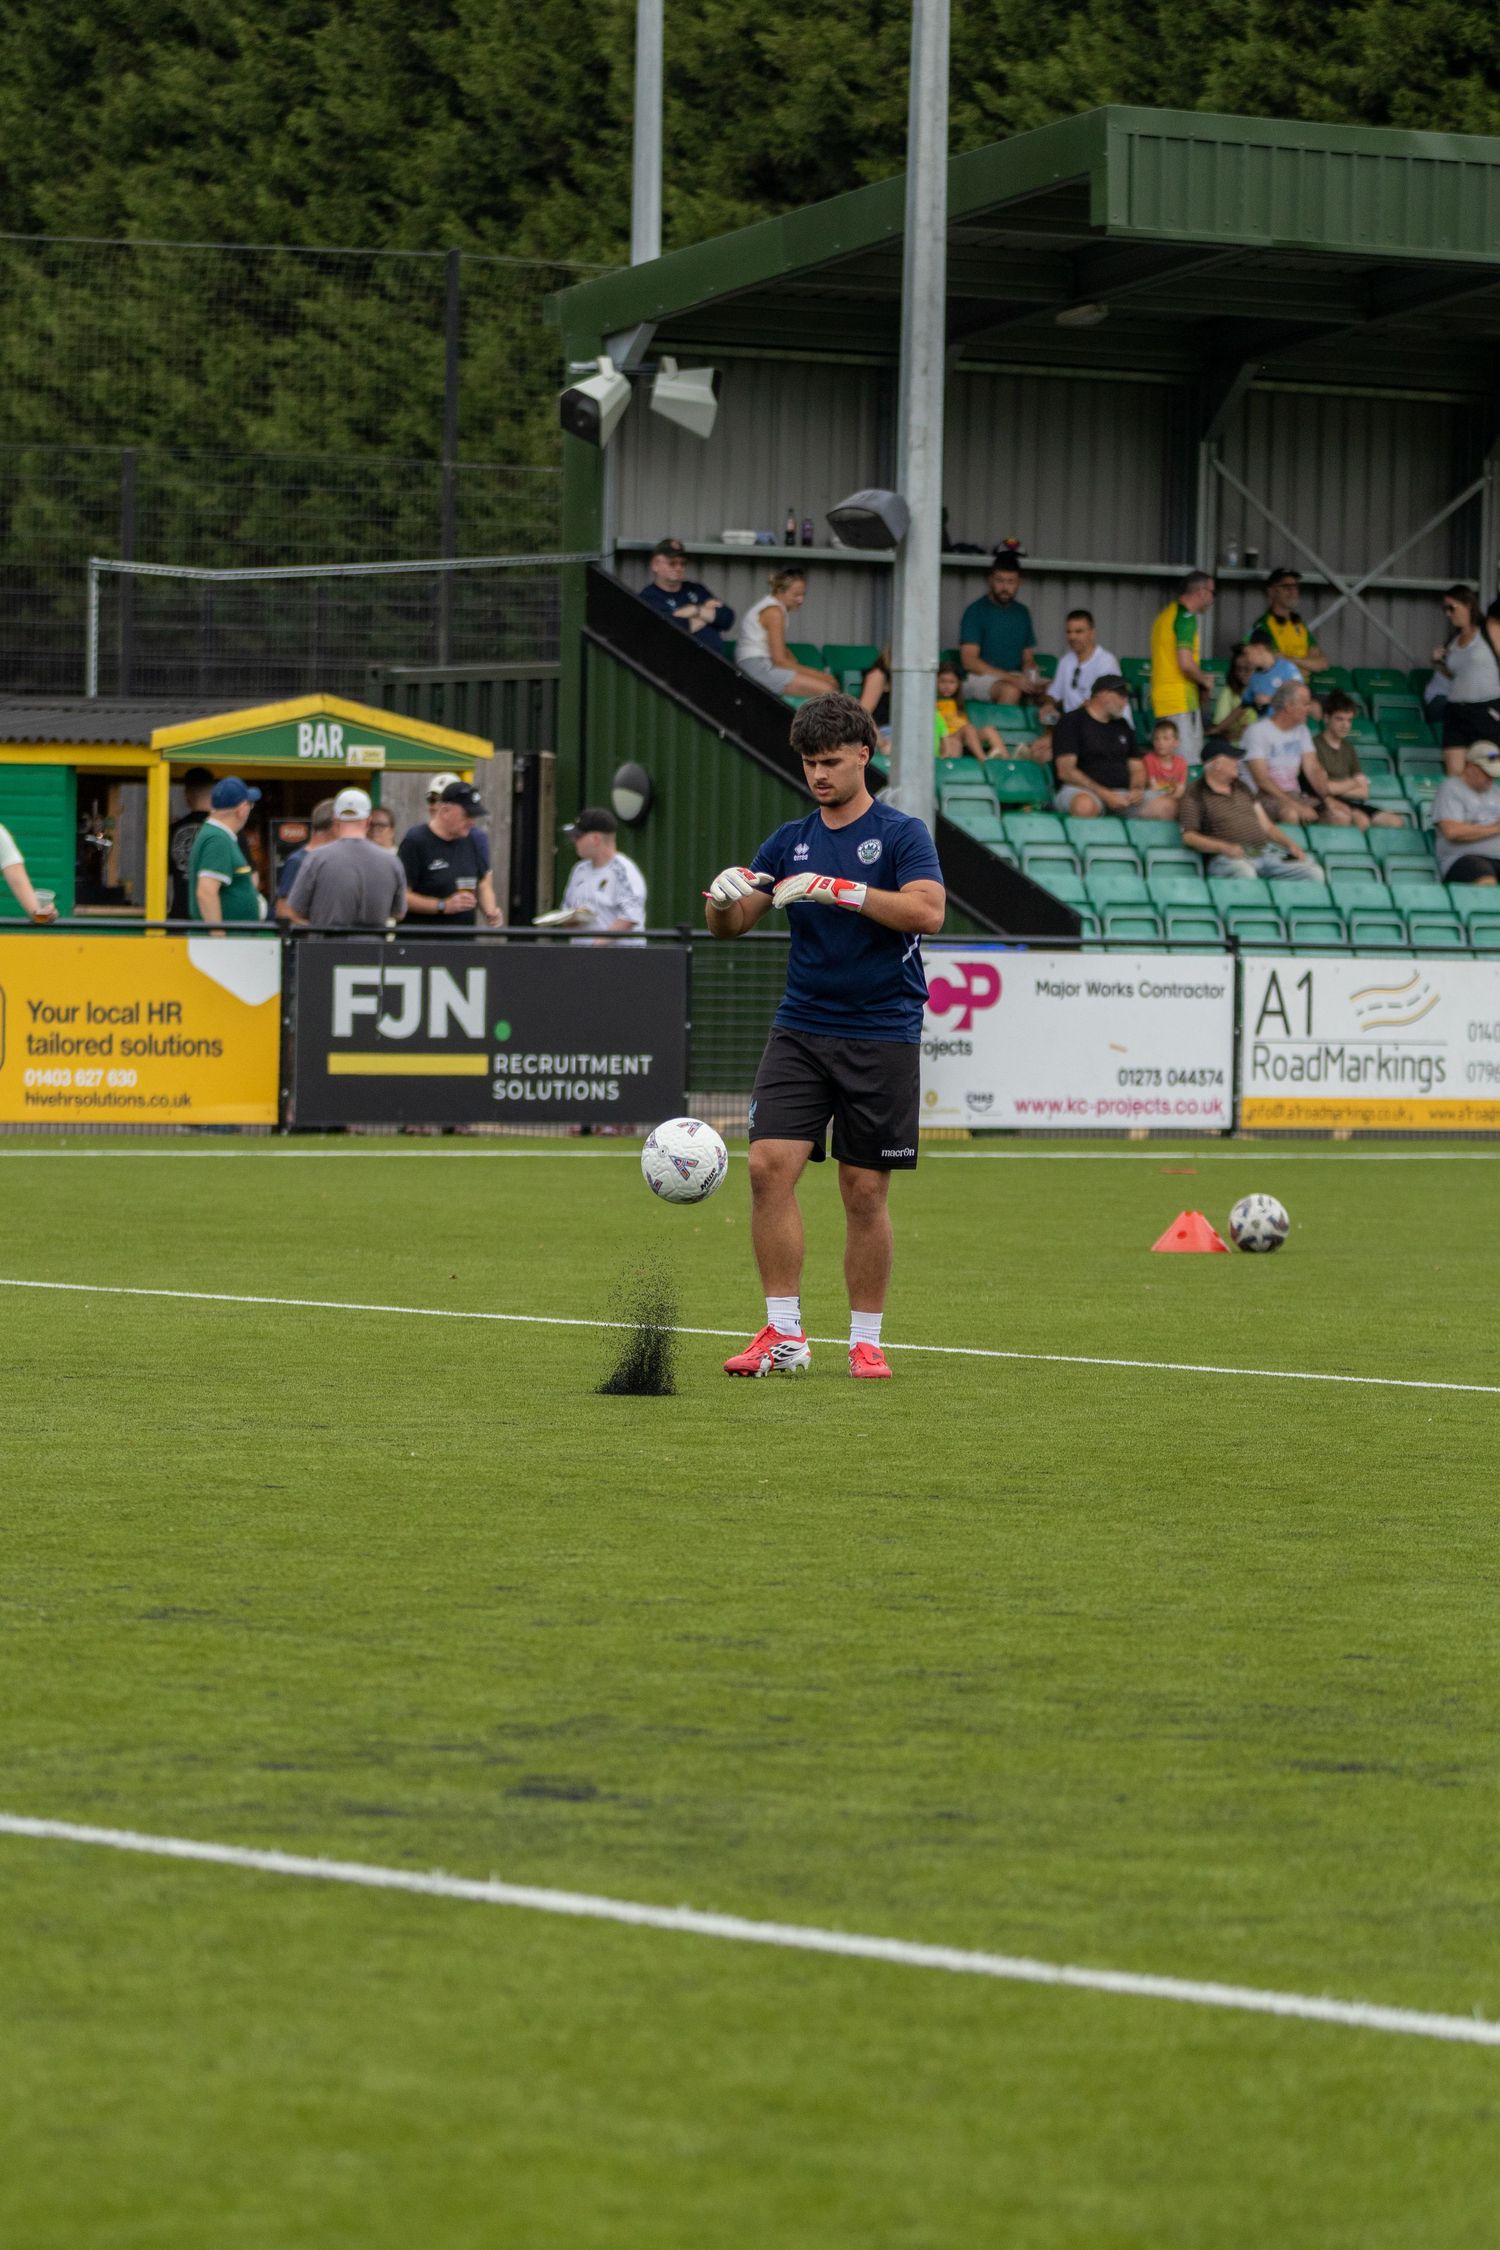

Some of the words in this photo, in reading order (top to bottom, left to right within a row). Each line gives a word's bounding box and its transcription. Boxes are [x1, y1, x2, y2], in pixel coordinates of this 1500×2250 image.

[298, 722, 344, 758] BAR
[1036, 980, 1082, 999] Major
[1085, 981, 1134, 998] Works
[1138, 982, 1225, 999] Contractor
[26, 1000, 79, 1024] Your
[86, 1001, 140, 1024] local
[147, 1002, 182, 1024] HR
[1255, 969, 1313, 1037] A1
[26, 1033, 113, 1056] tailored
[120, 1034, 224, 1058] solutions
[920, 1037, 973, 1062] ojects
[493, 1054, 653, 1076] RECRUITMENT
[1252, 1045, 1447, 1093] RoadMarkings
[24, 1068, 71, 1087] 01403
[1118, 1068, 1162, 1087] 01273
[1167, 1069, 1224, 1087] 044374
[25, 1091, 192, 1108] hivehrsolutions.co.uk
[492, 1080, 620, 1101] SOLUTIONS
[1014, 1097, 1223, 1117] www.kc-projects.co.uk
[881, 1147, 915, 1158] macron
